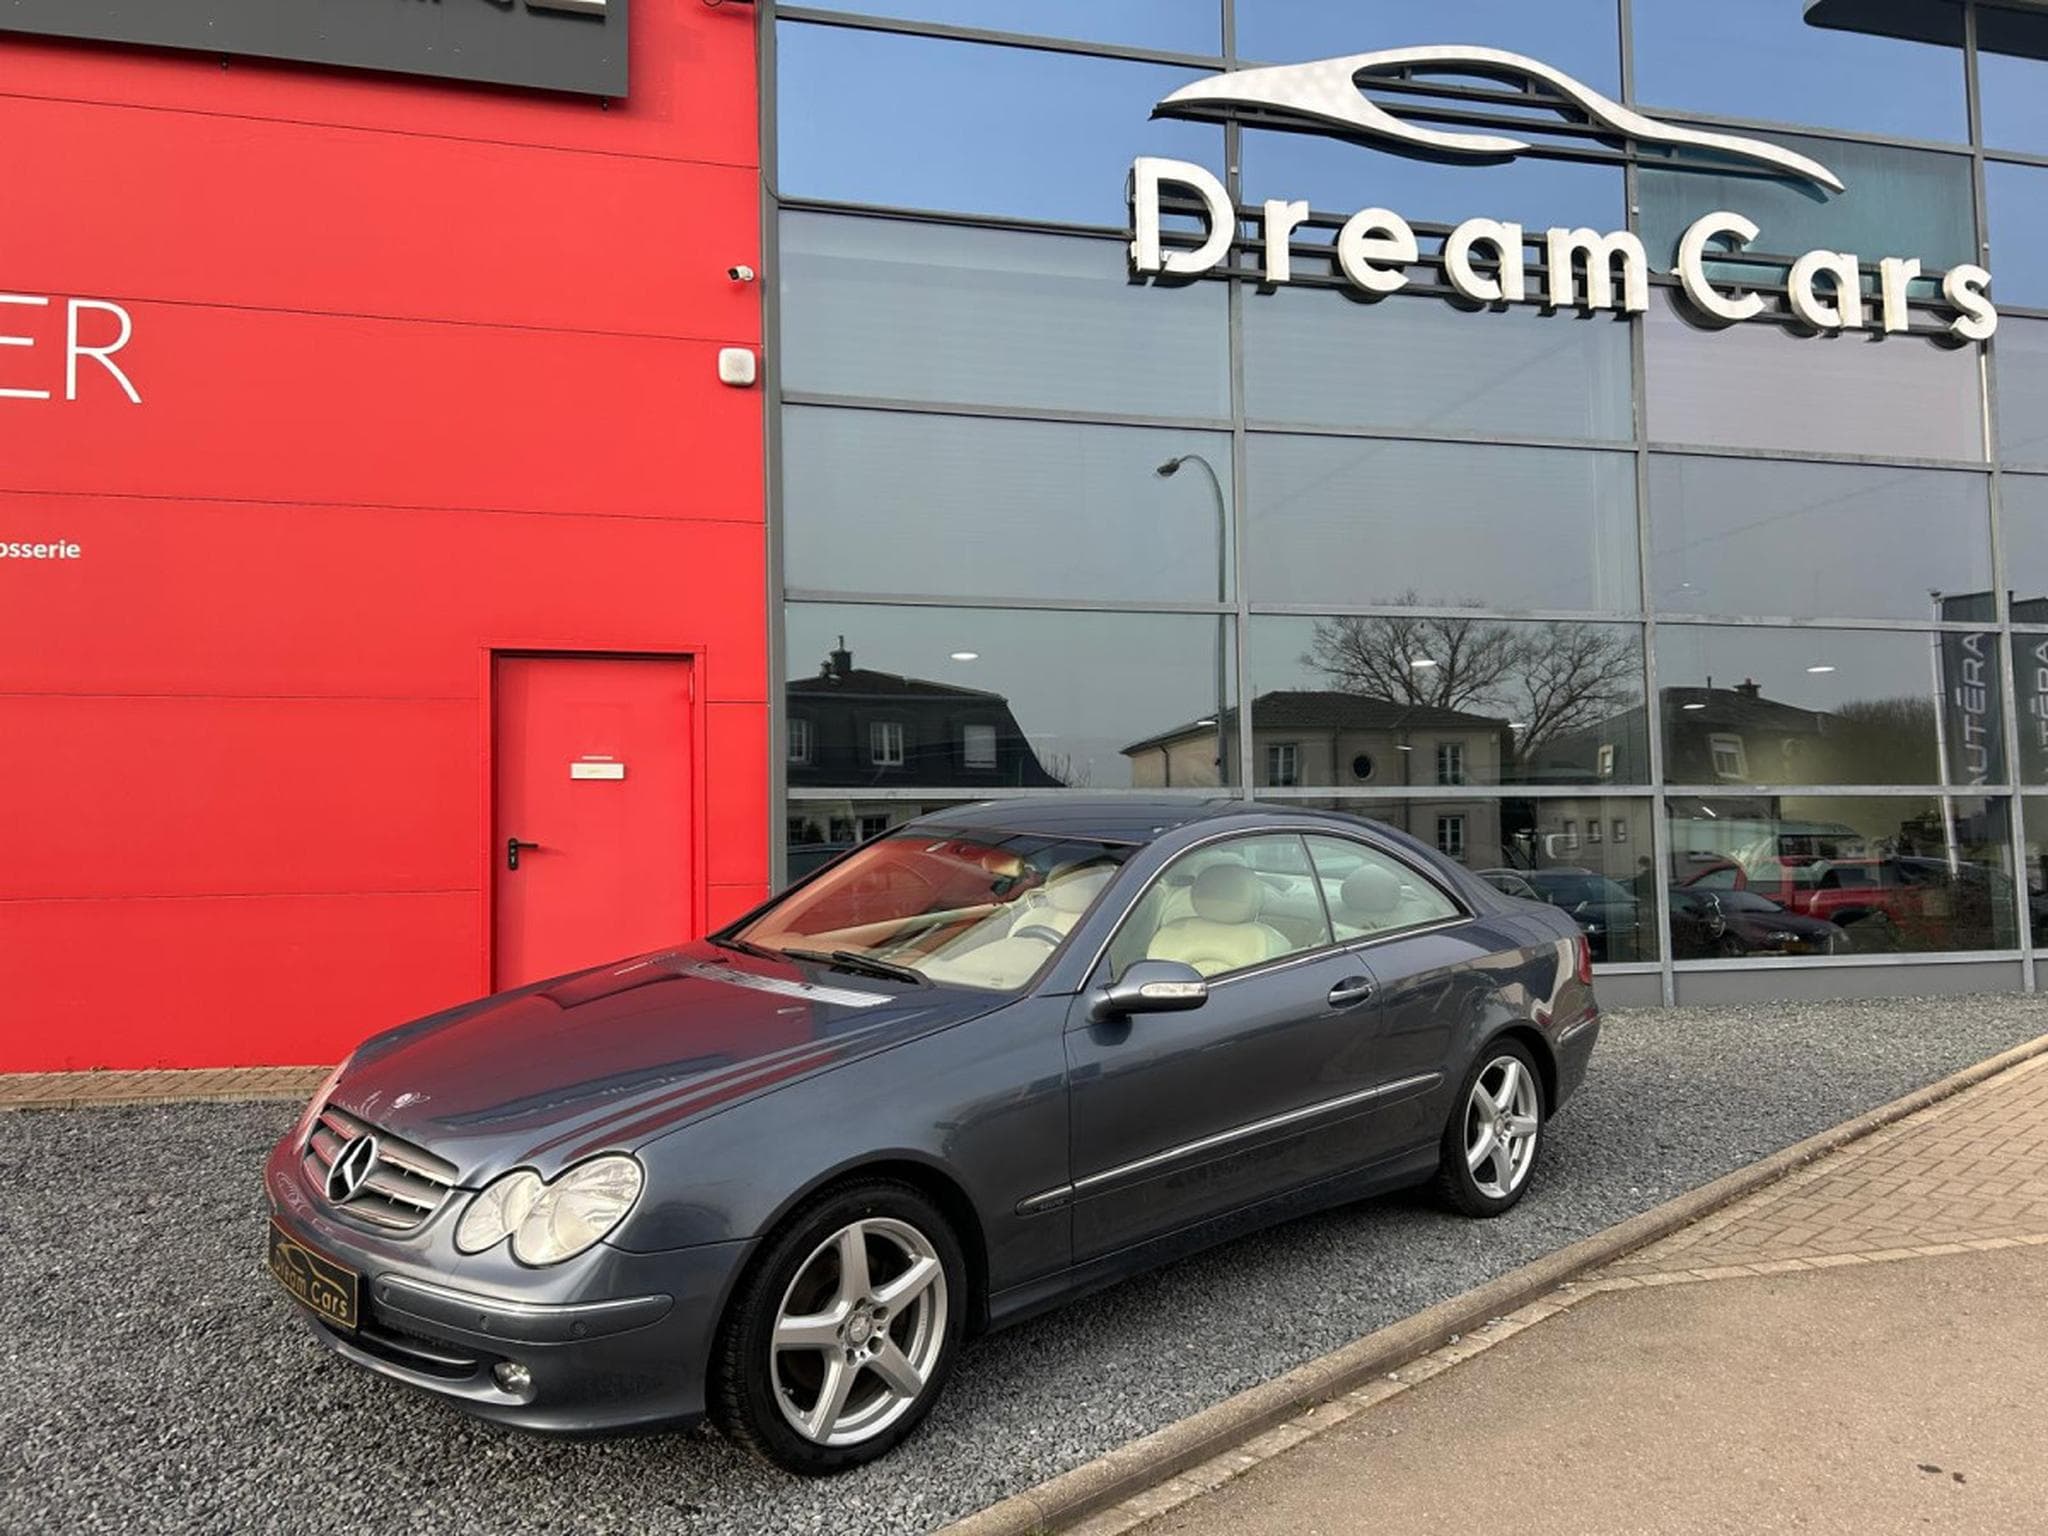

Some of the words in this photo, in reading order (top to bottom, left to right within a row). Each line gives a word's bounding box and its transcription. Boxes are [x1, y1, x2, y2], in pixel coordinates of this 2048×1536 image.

[1134, 157, 1649, 312] Dream
[1678, 211, 1998, 340] Cars
[0, 294, 143, 404] ER
[0, 539, 81, 558] osserie
[312, 1282, 347, 1316] Cars
